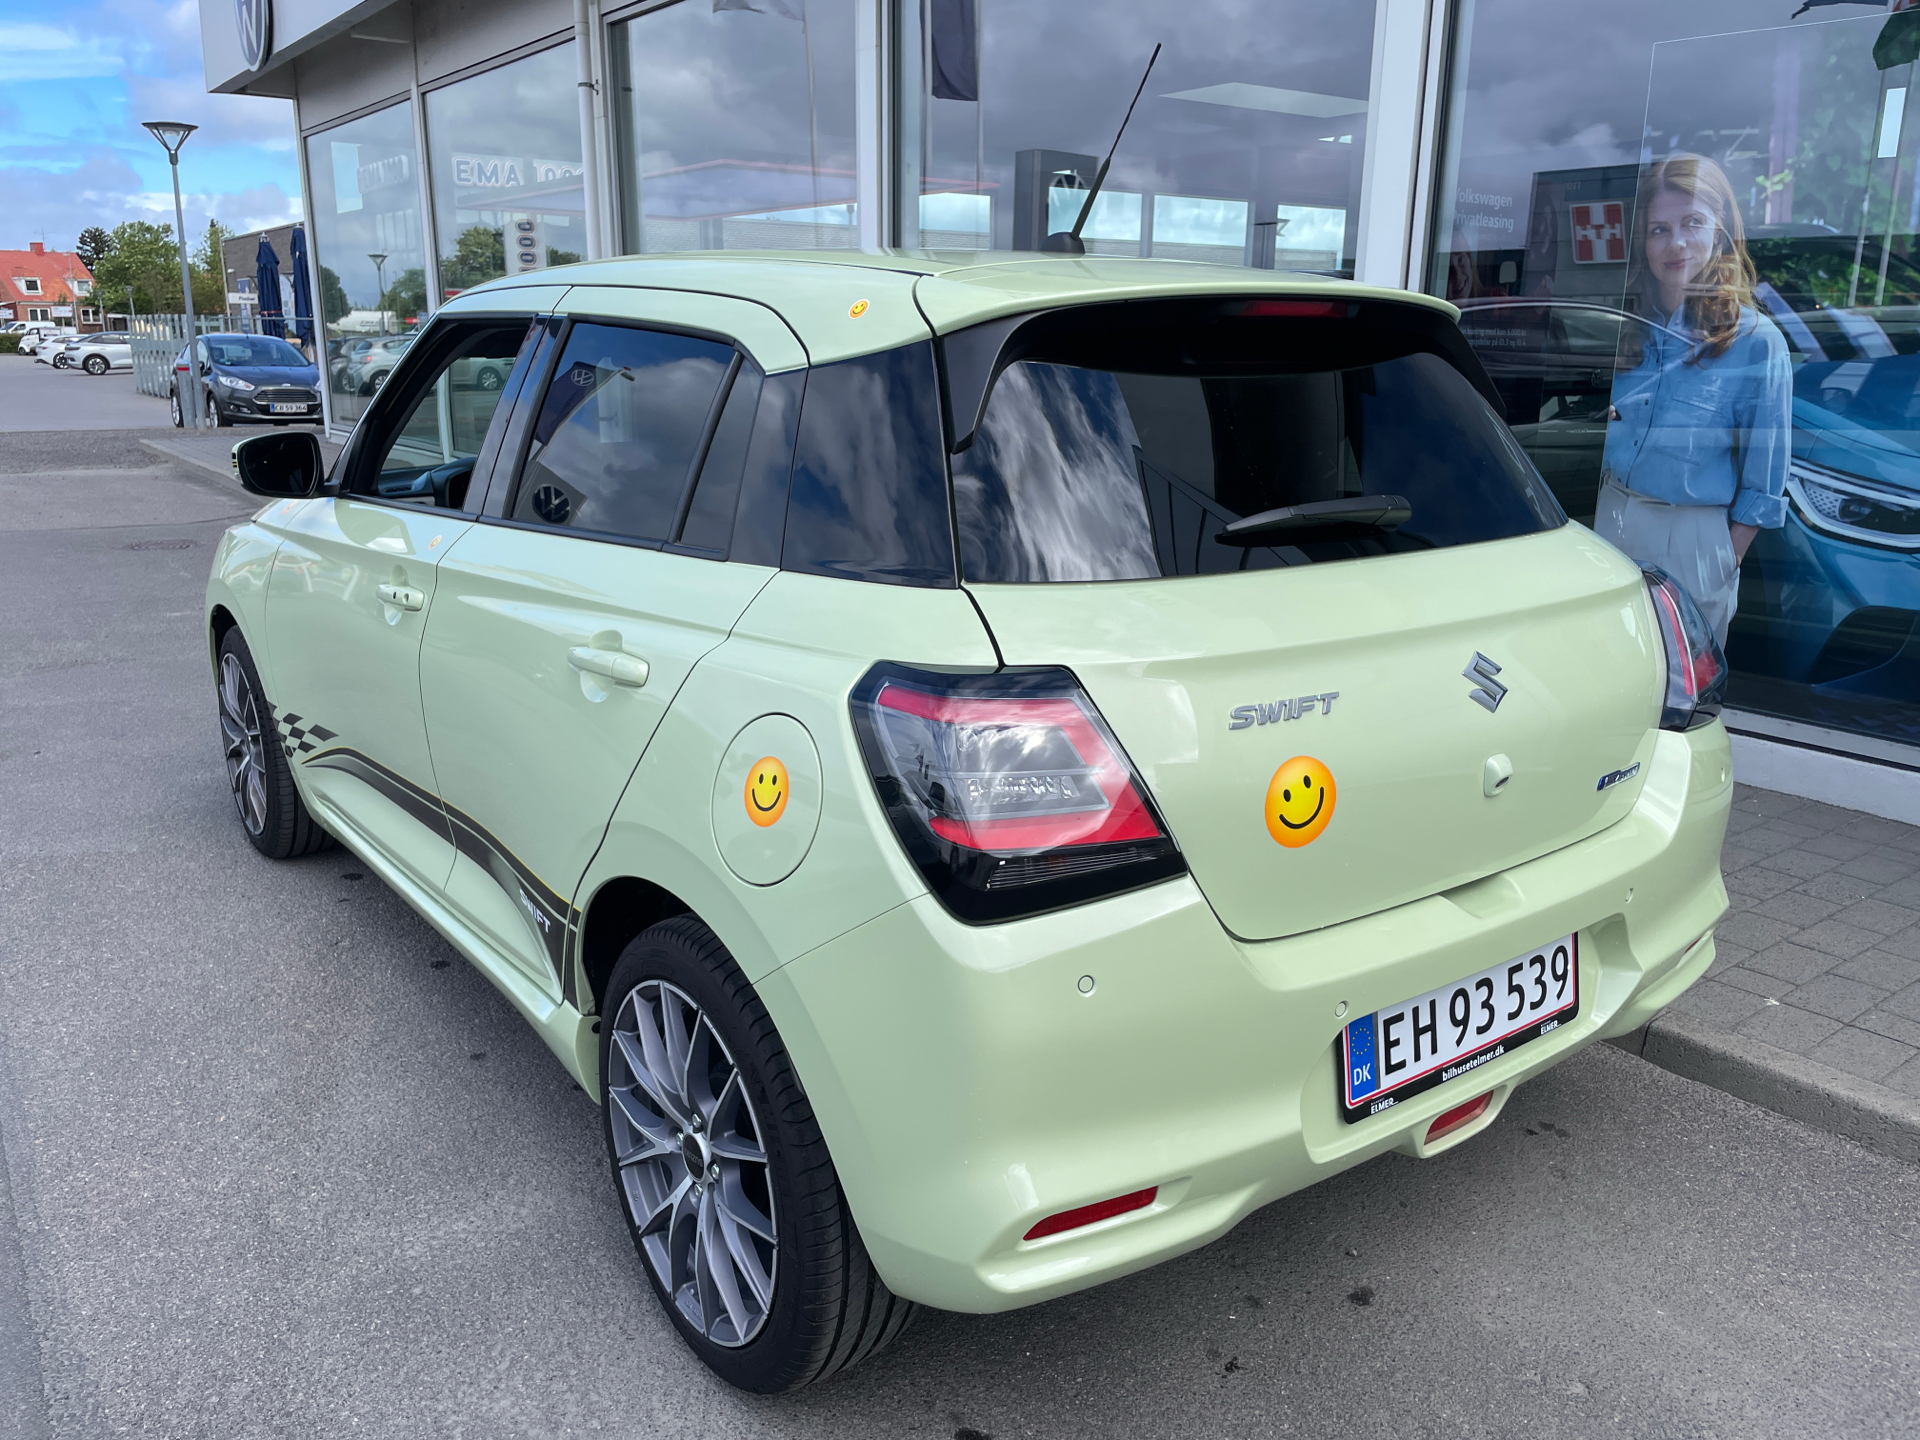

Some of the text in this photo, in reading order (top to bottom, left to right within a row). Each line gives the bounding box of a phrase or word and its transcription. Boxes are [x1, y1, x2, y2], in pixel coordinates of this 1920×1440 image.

[515, 219, 537, 272] 000
[1229, 691, 1340, 730] SWIFT
[519, 888, 551, 933] SWIFT
[1383, 945, 1569, 1076] EH 93 539
[1353, 1063, 1371, 1086] DK
[1442, 1045, 1505, 1082] bilhusetelmer.dk
[1371, 1098, 1394, 1115] ELMER
